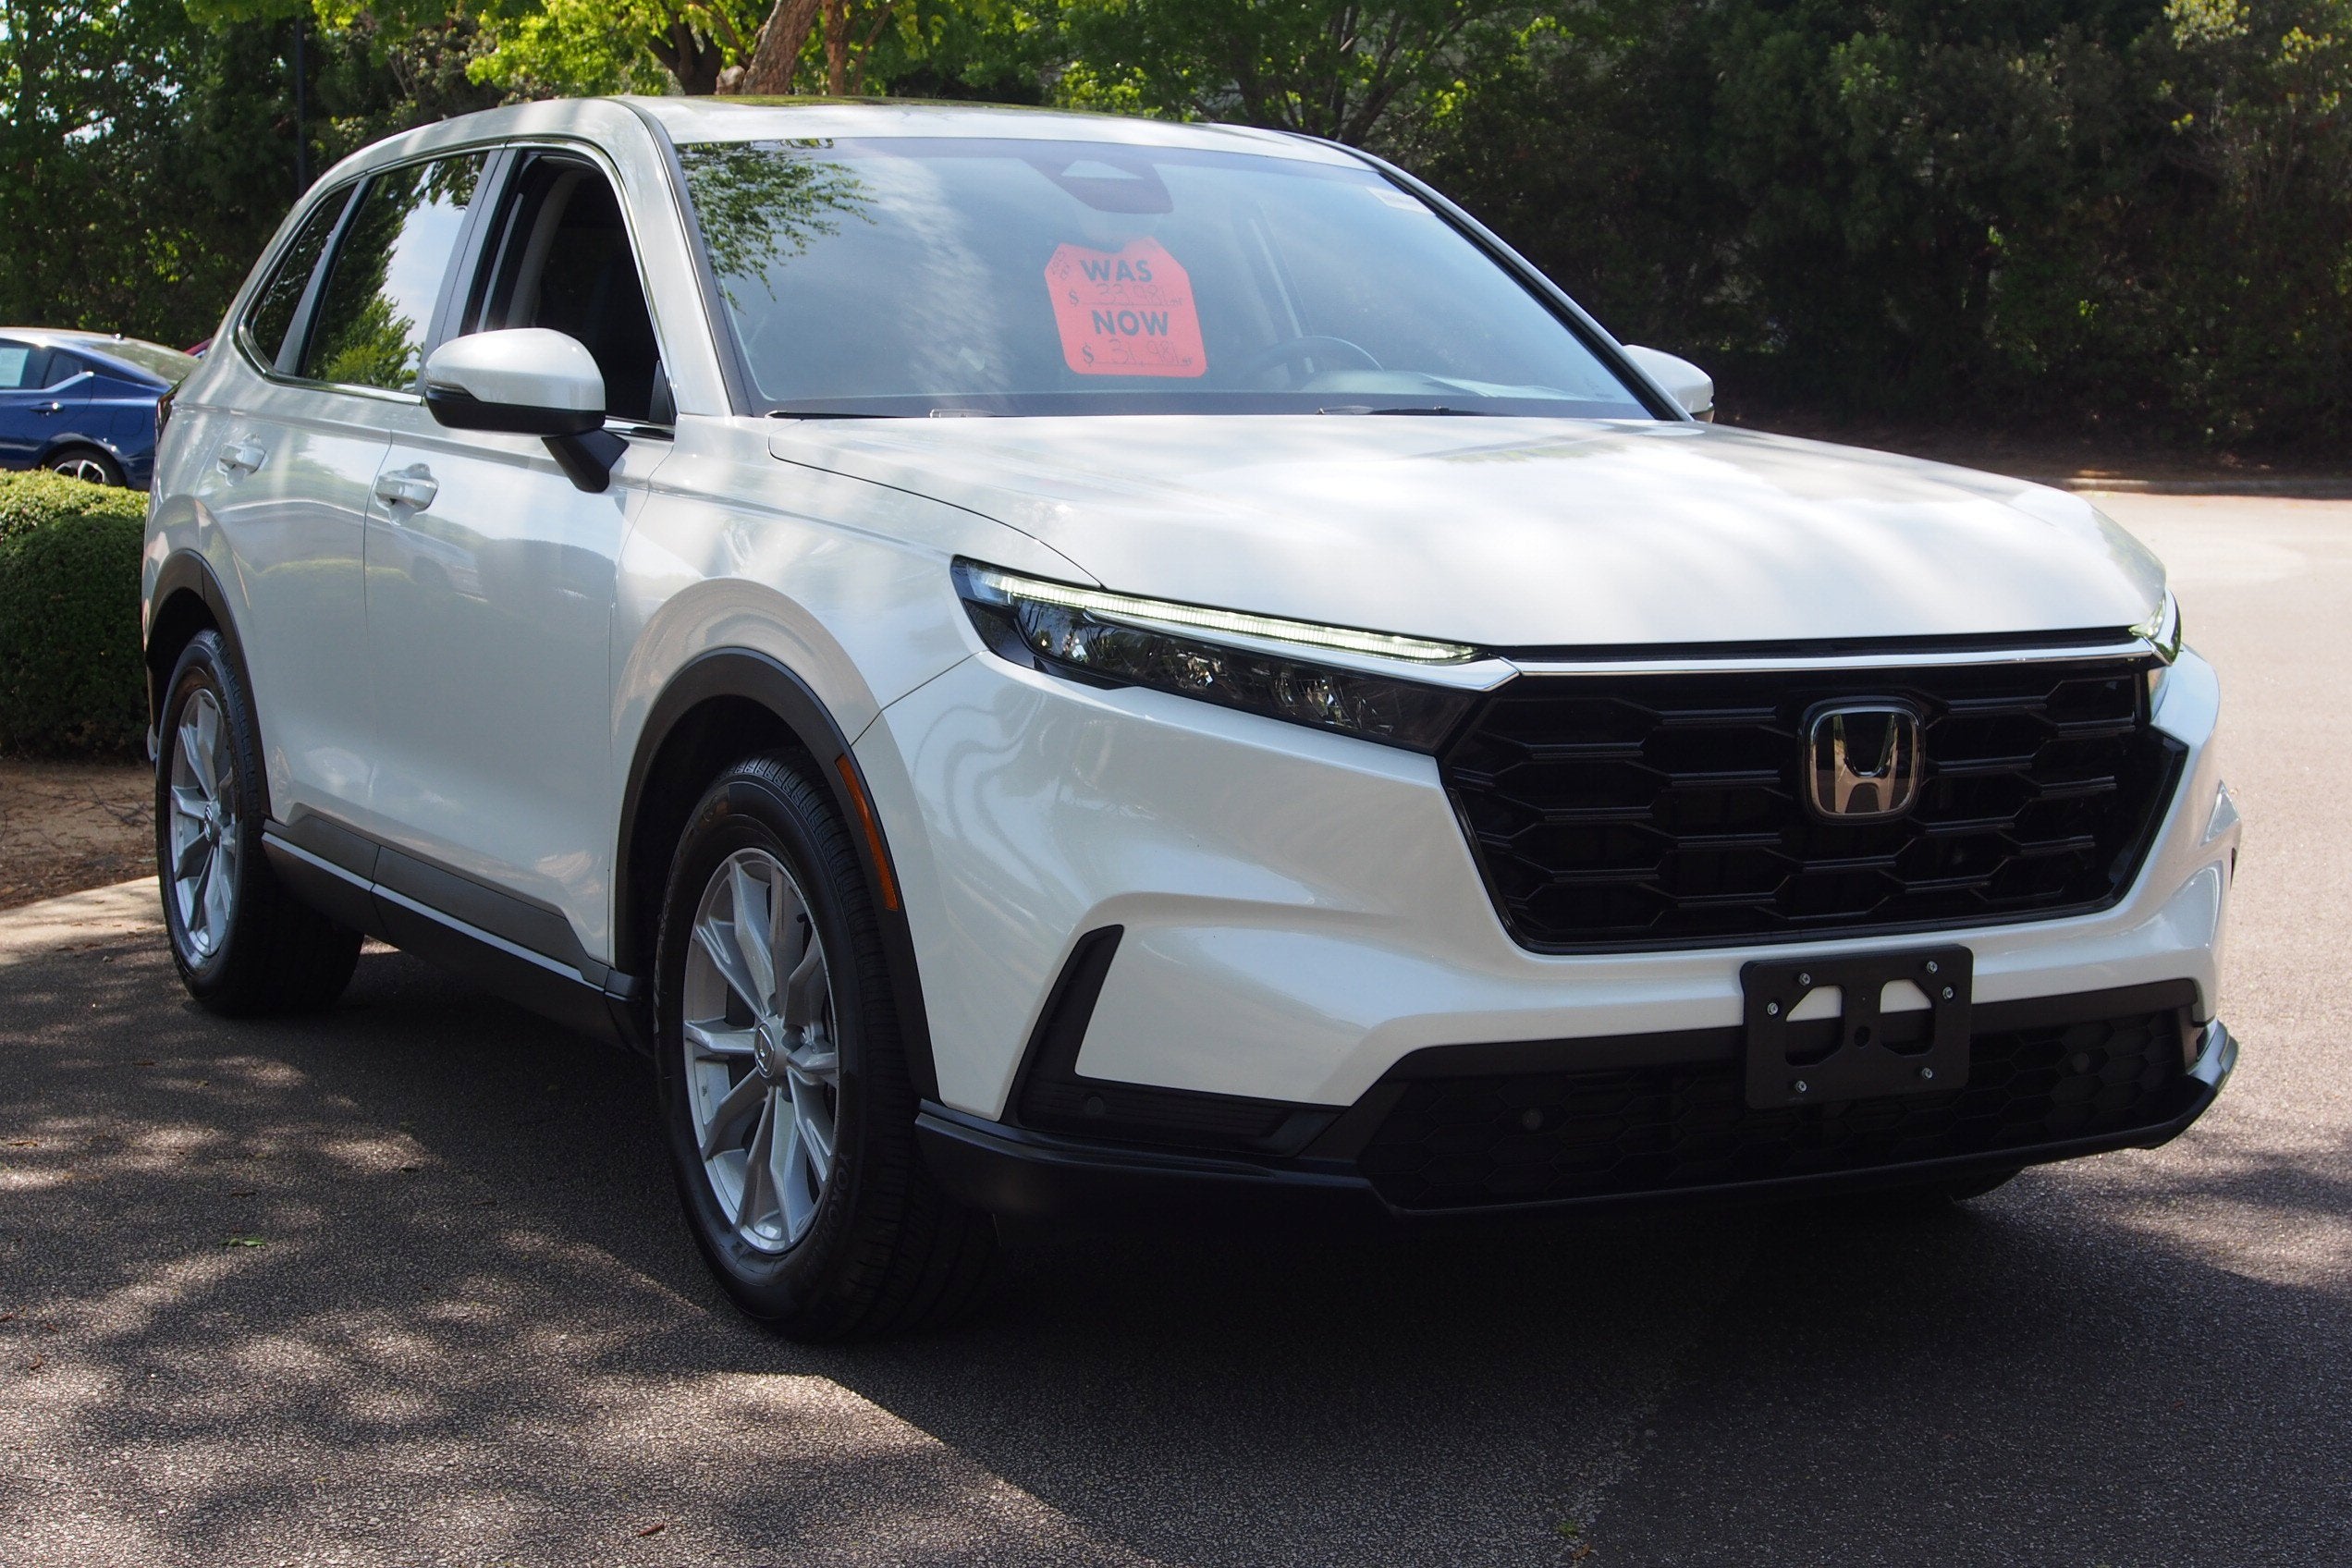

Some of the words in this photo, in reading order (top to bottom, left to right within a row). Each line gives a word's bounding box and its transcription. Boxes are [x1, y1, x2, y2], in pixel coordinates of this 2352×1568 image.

[1080, 259, 1153, 283] WAS
[1069, 288, 1080, 307] $
[1091, 310, 1169, 337] NOW
[1082, 342, 1095, 367] $
